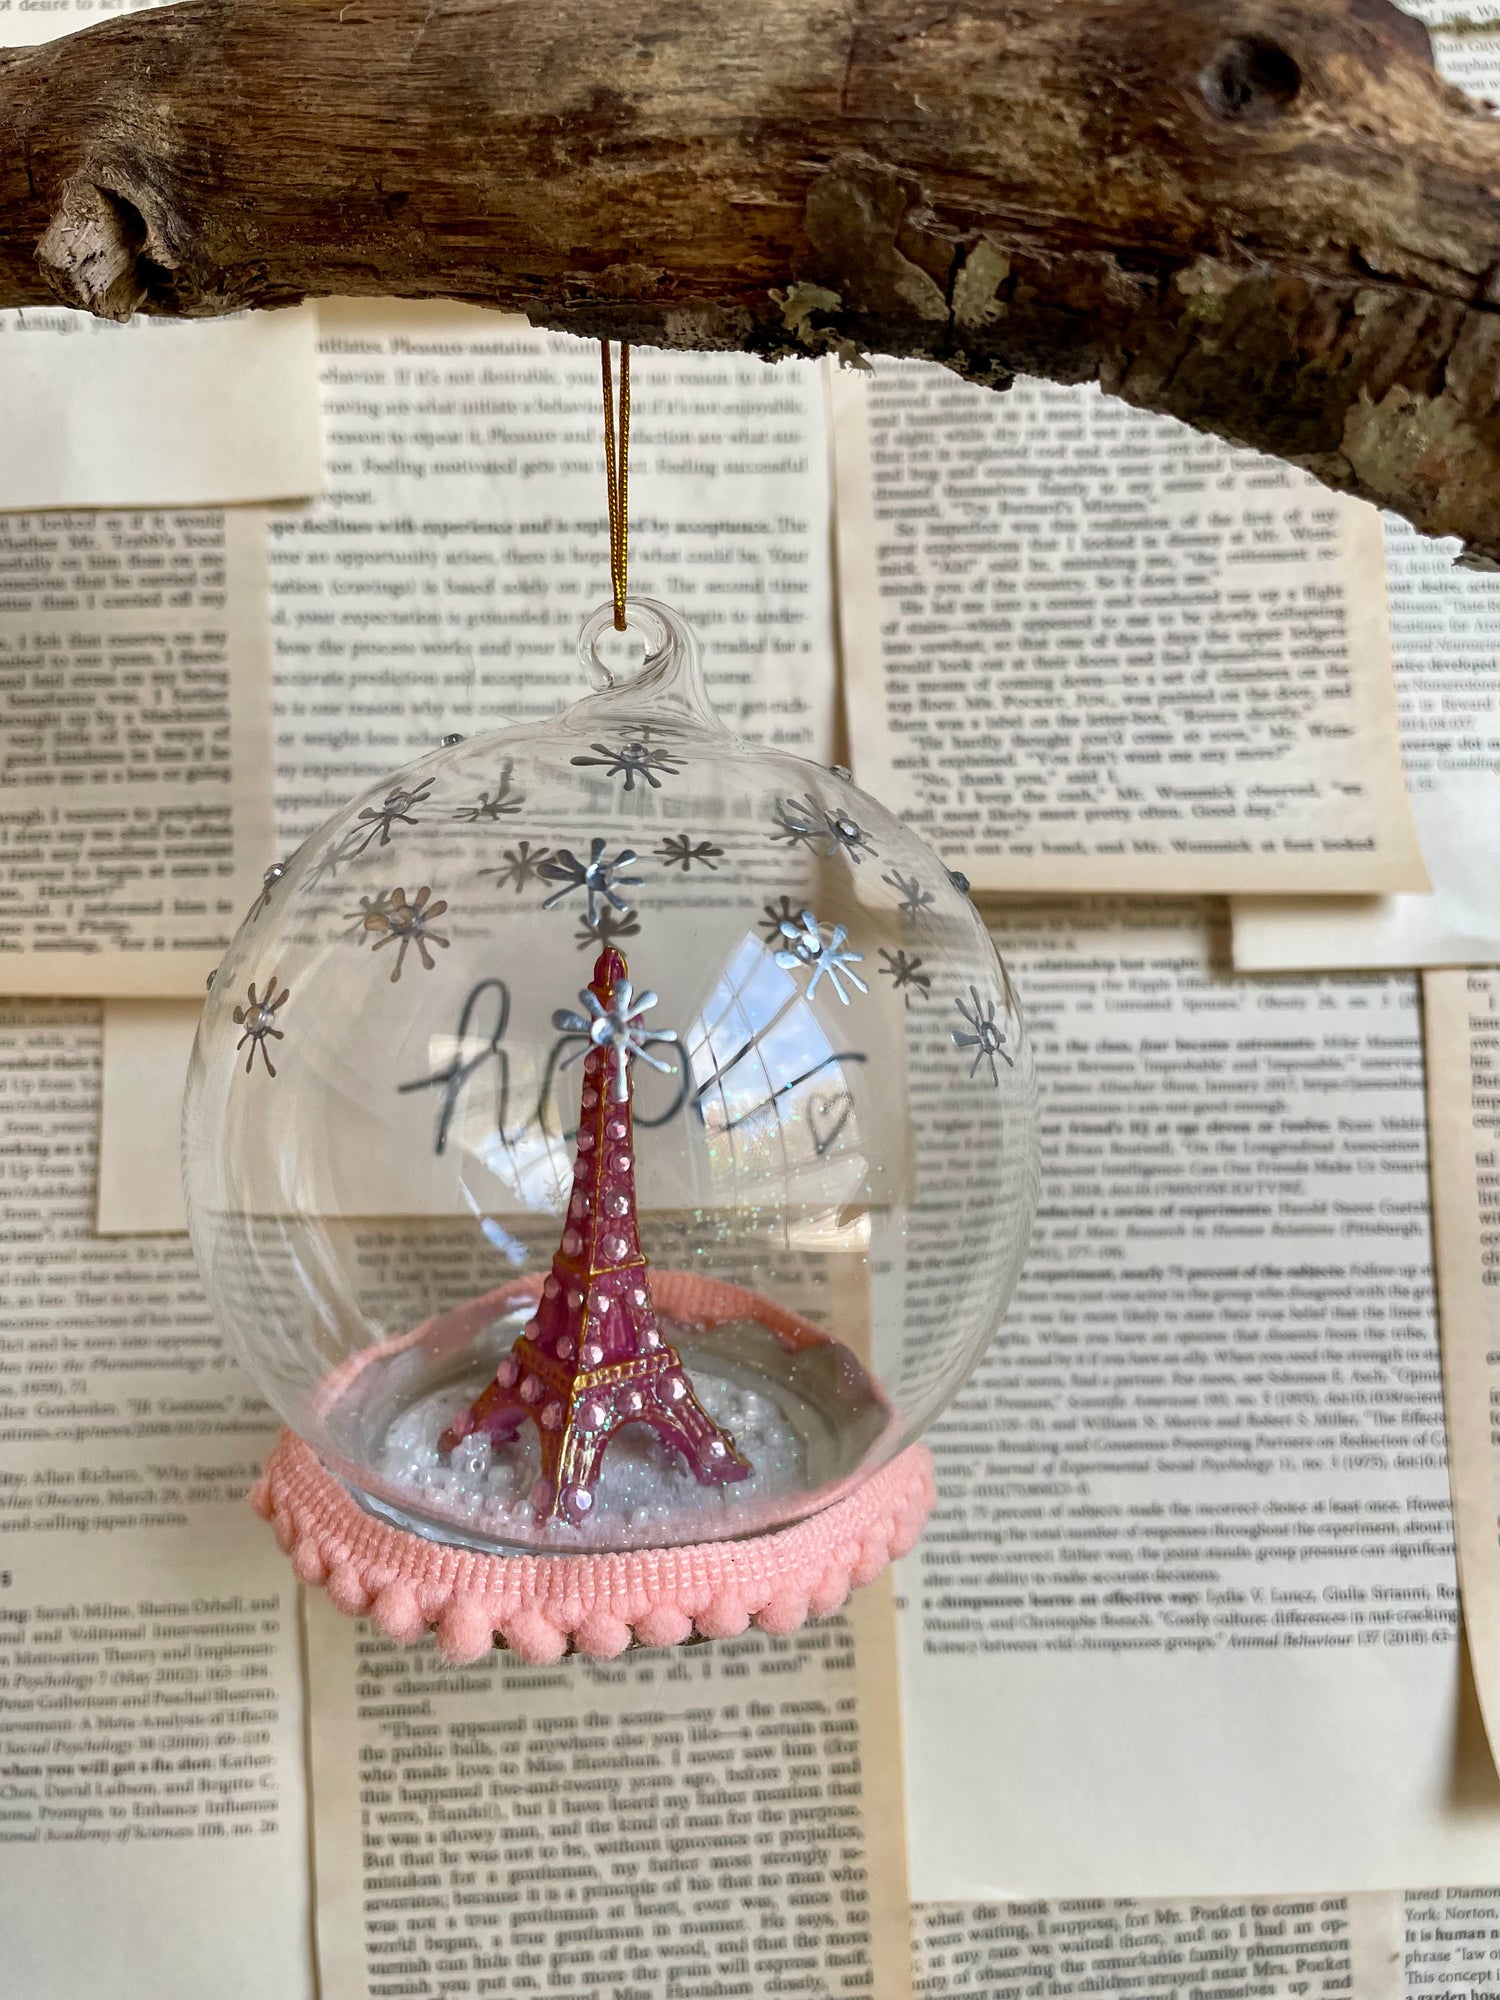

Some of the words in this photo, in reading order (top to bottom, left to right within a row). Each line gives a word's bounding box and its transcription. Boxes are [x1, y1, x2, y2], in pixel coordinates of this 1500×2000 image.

[1404, 1888, 1439, 1903] Jared
[1404, 1907, 1440, 1921] York:
[1445, 1907, 1499, 1920] Norton,
[1405, 1929, 1417, 1943] It
[1420, 1928, 1432, 1942] is
[1435, 1927, 1486, 1941] human
[1405, 1949, 1451, 1968] phrase
[1405, 1970, 1435, 1985] This
[1438, 1970, 1492, 1985] concept
